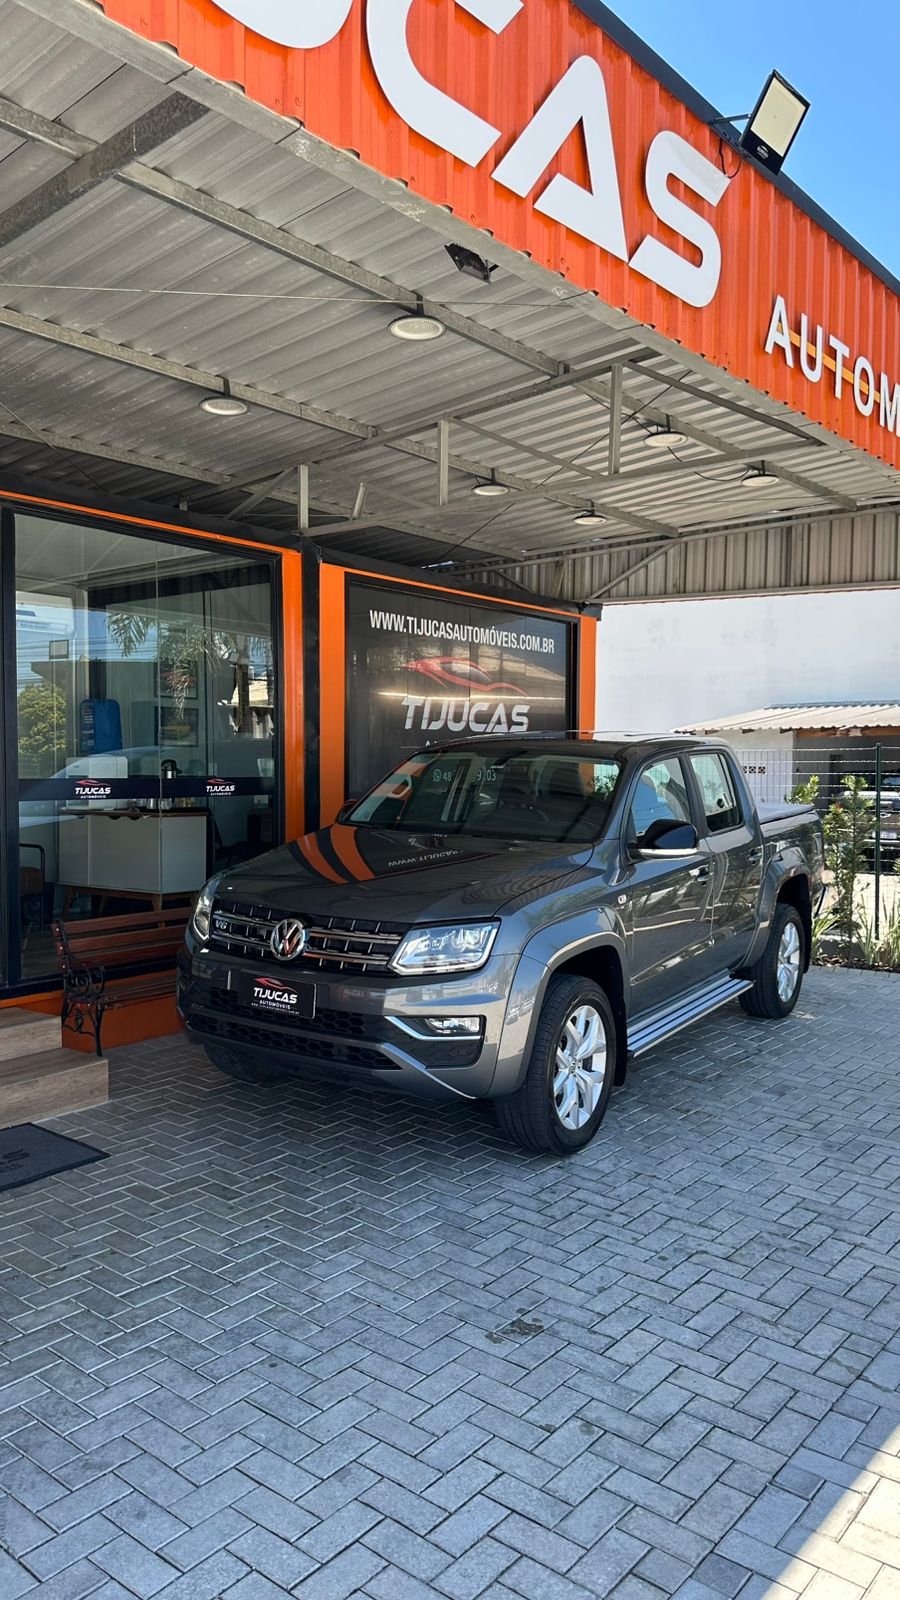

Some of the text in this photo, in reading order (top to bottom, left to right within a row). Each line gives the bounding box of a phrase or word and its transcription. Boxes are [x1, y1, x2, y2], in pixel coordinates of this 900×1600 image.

[369, 609, 555, 654] WWW.TIJUCASAUTOMÓVEIS.COM.BR
[401, 697, 530, 733] TIJUCAS
[75, 787, 112, 795] TIJUCAS
[206, 785, 236, 793] TIJUCAS
[253, 987, 298, 1004] TIJUCAS
